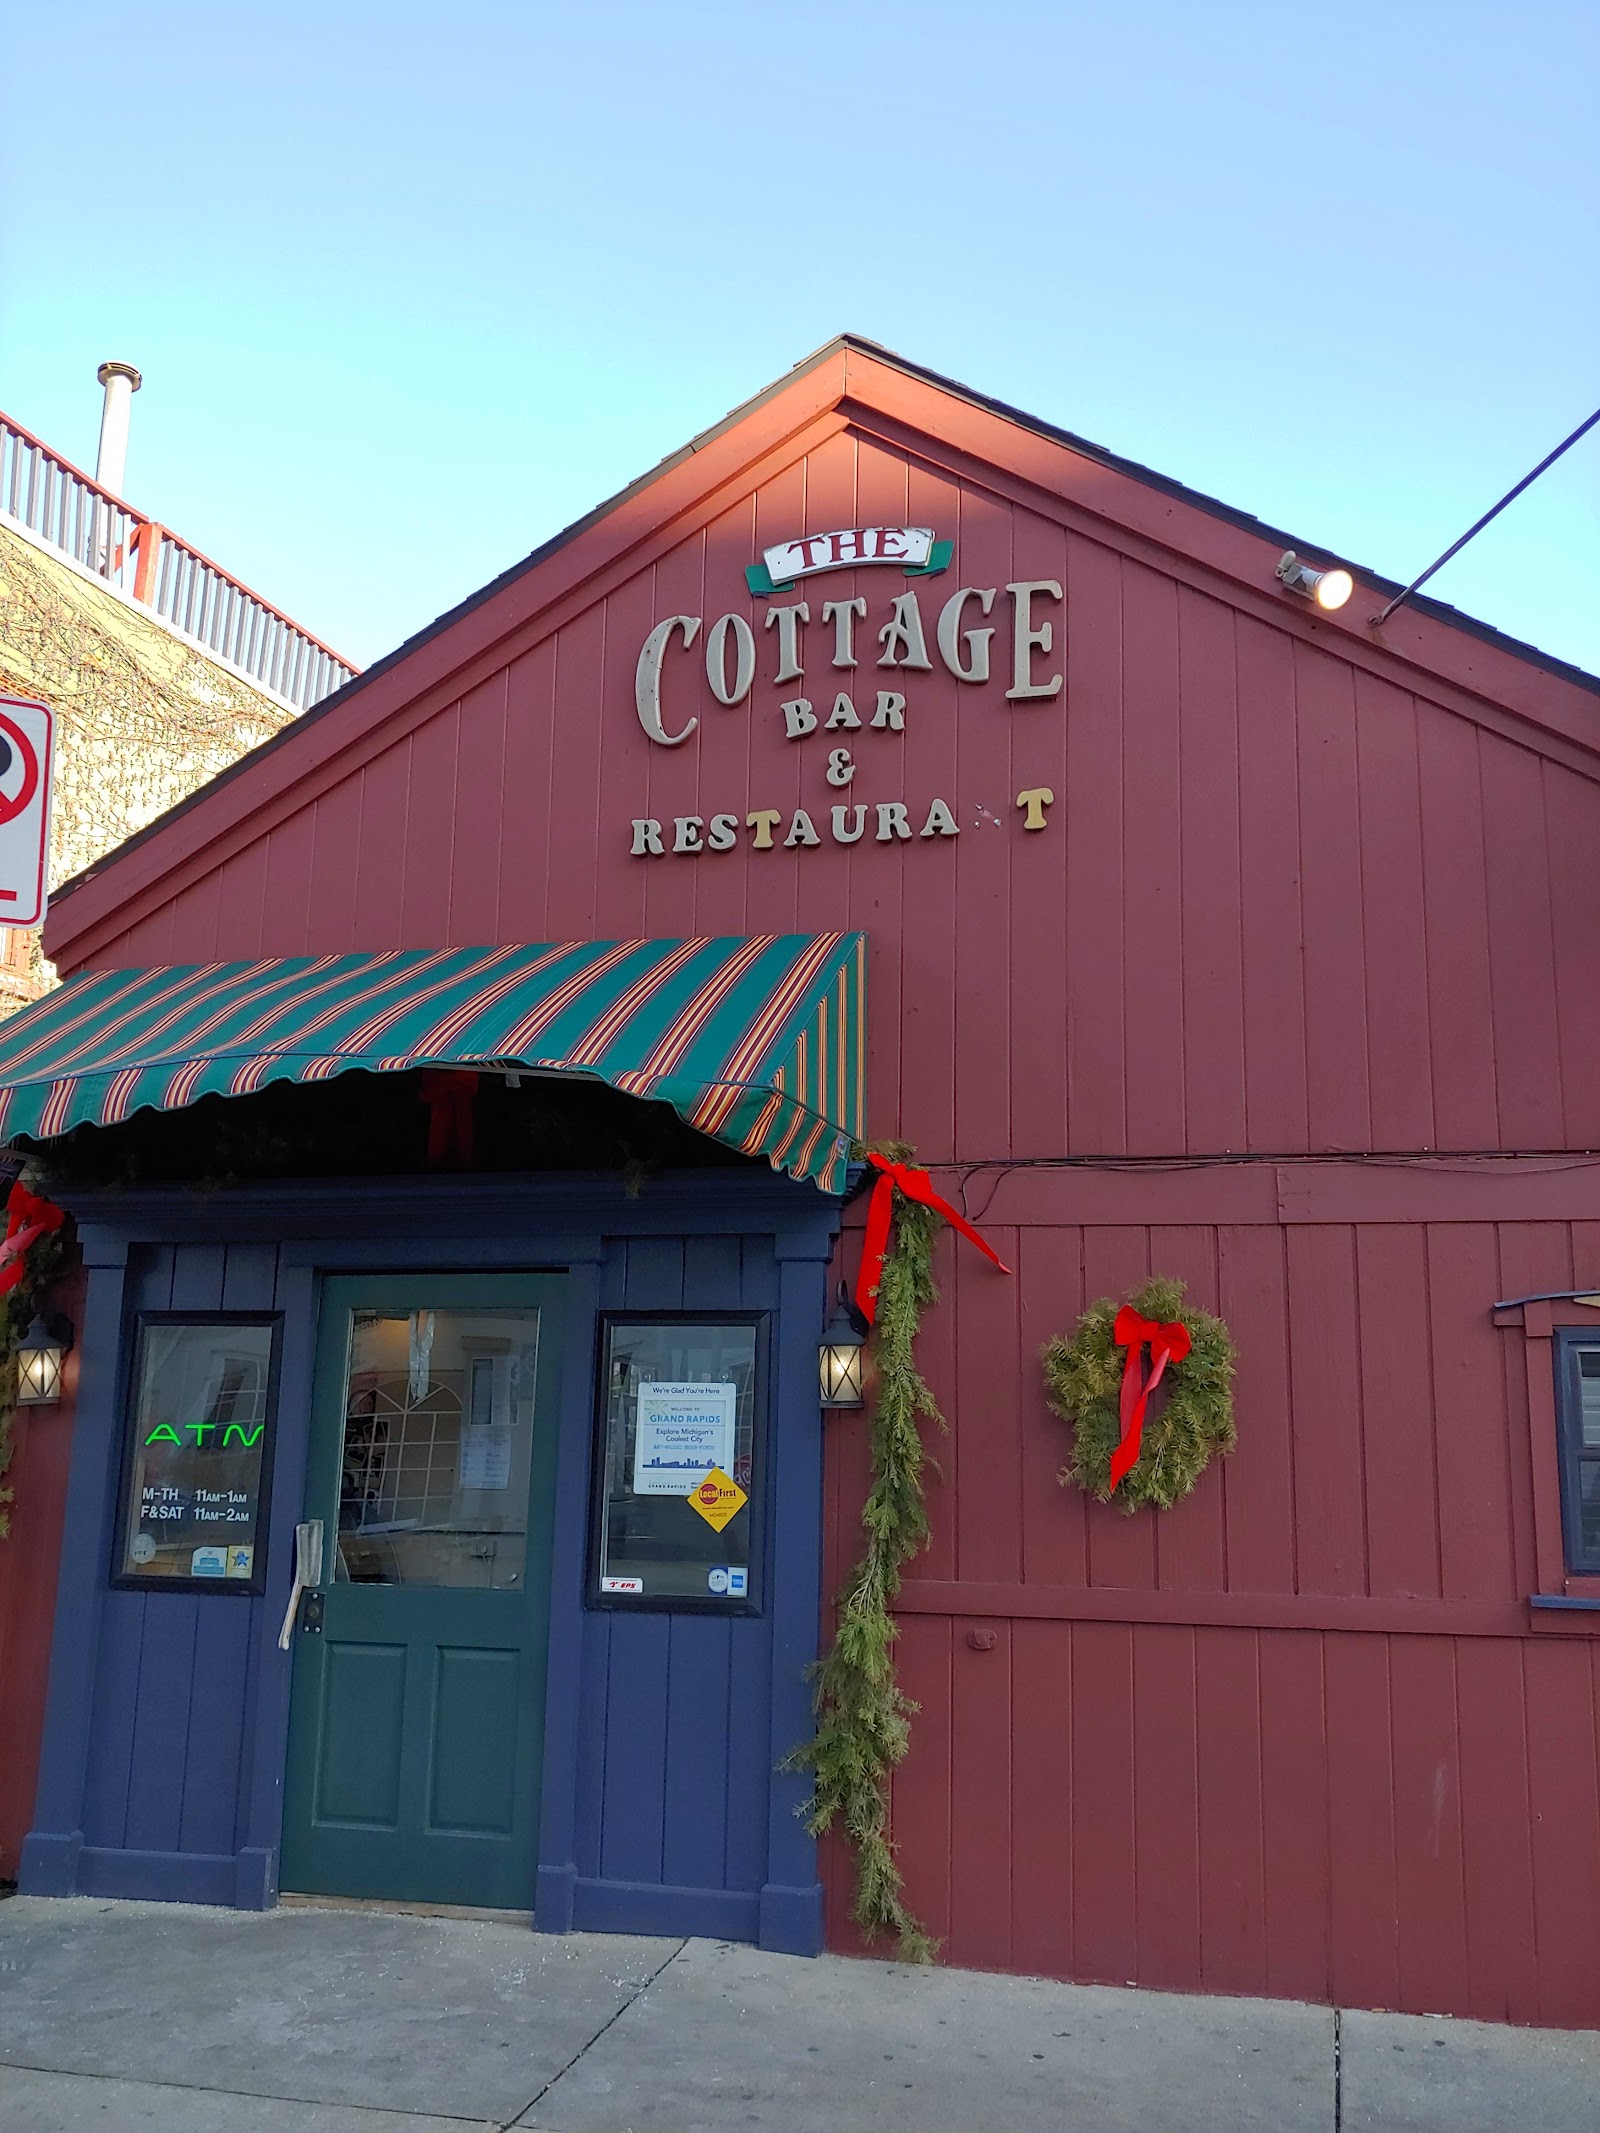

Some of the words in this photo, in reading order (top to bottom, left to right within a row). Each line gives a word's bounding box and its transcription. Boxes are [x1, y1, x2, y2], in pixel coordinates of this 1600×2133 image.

[788, 529, 909, 569] THE
[635, 580, 1064, 746] COTTAGE
[780, 691, 906, 739] BAR
[826, 748, 856, 786] &
[650, 1414, 684, 1422] GRAND
[686, 1415, 721, 1423] RAPIDS
[681, 1428, 714, 1436] Michigan's
[690, 1435, 703, 1443] City
[142, 1487, 179, 1501] M-TH
[195, 1489, 247, 1503] 11AM-1AM
[699, 1489, 718, 1499] Local
[719, 1488, 736, 1497] First
[140, 1505, 185, 1520] F&SAT
[193, 1507, 249, 1522] 11AM-2AM
